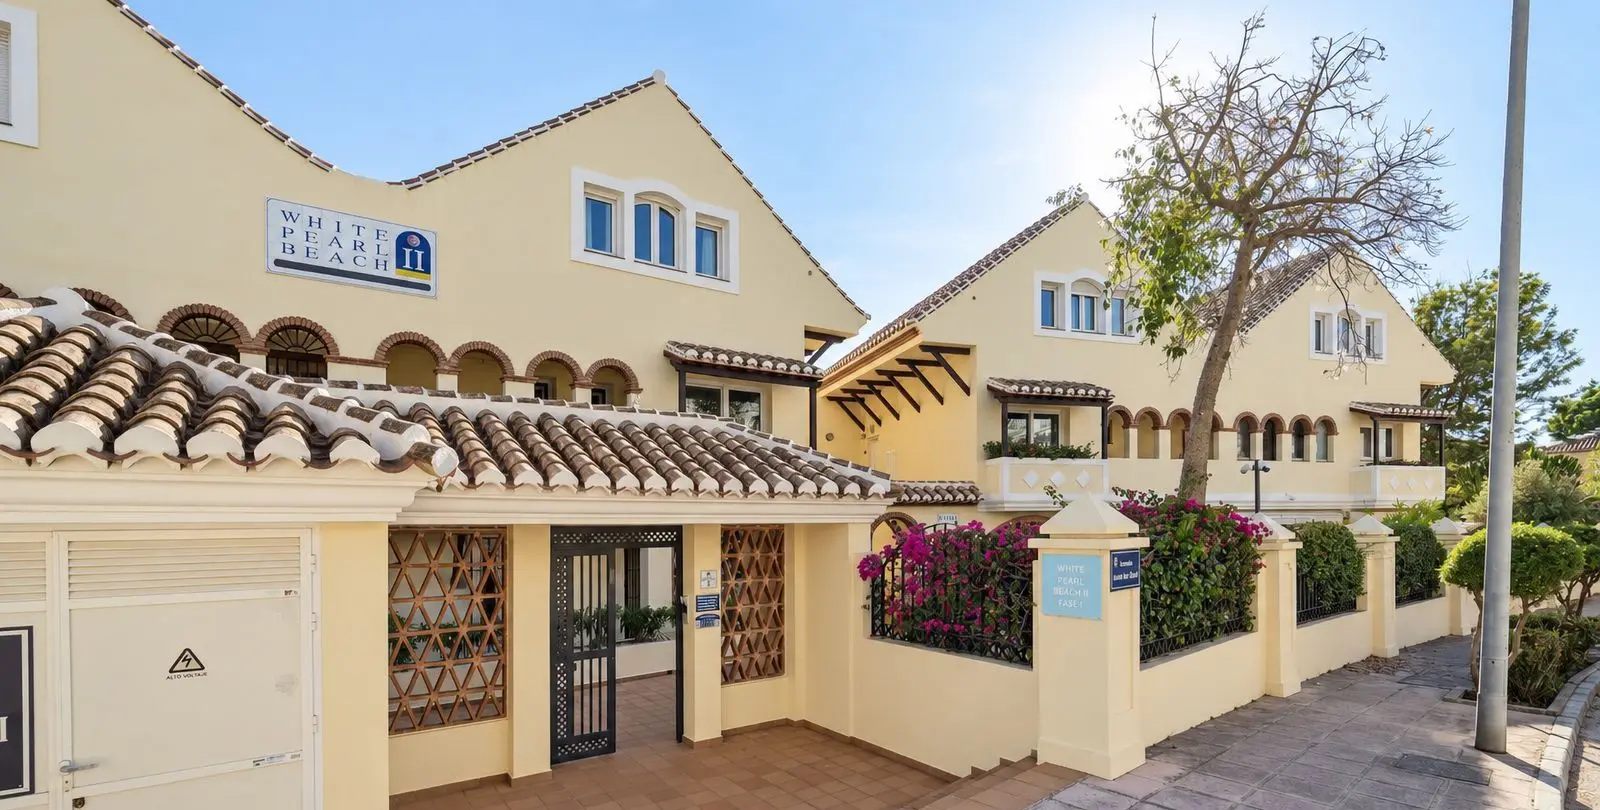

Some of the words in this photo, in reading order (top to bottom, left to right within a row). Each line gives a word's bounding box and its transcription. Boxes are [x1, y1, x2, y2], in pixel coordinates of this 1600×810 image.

[280, 209, 389, 242] WHITE
[282, 227, 389, 257] PEARL
[281, 242, 388, 272] BEACH
[402, 247, 425, 272] II
[1057, 564, 1085, 574] WHITE
[1057, 576, 1085, 586] PEARL
[1053, 586, 1081, 597] BEACH
[1057, 599, 1079, 608] FASE
